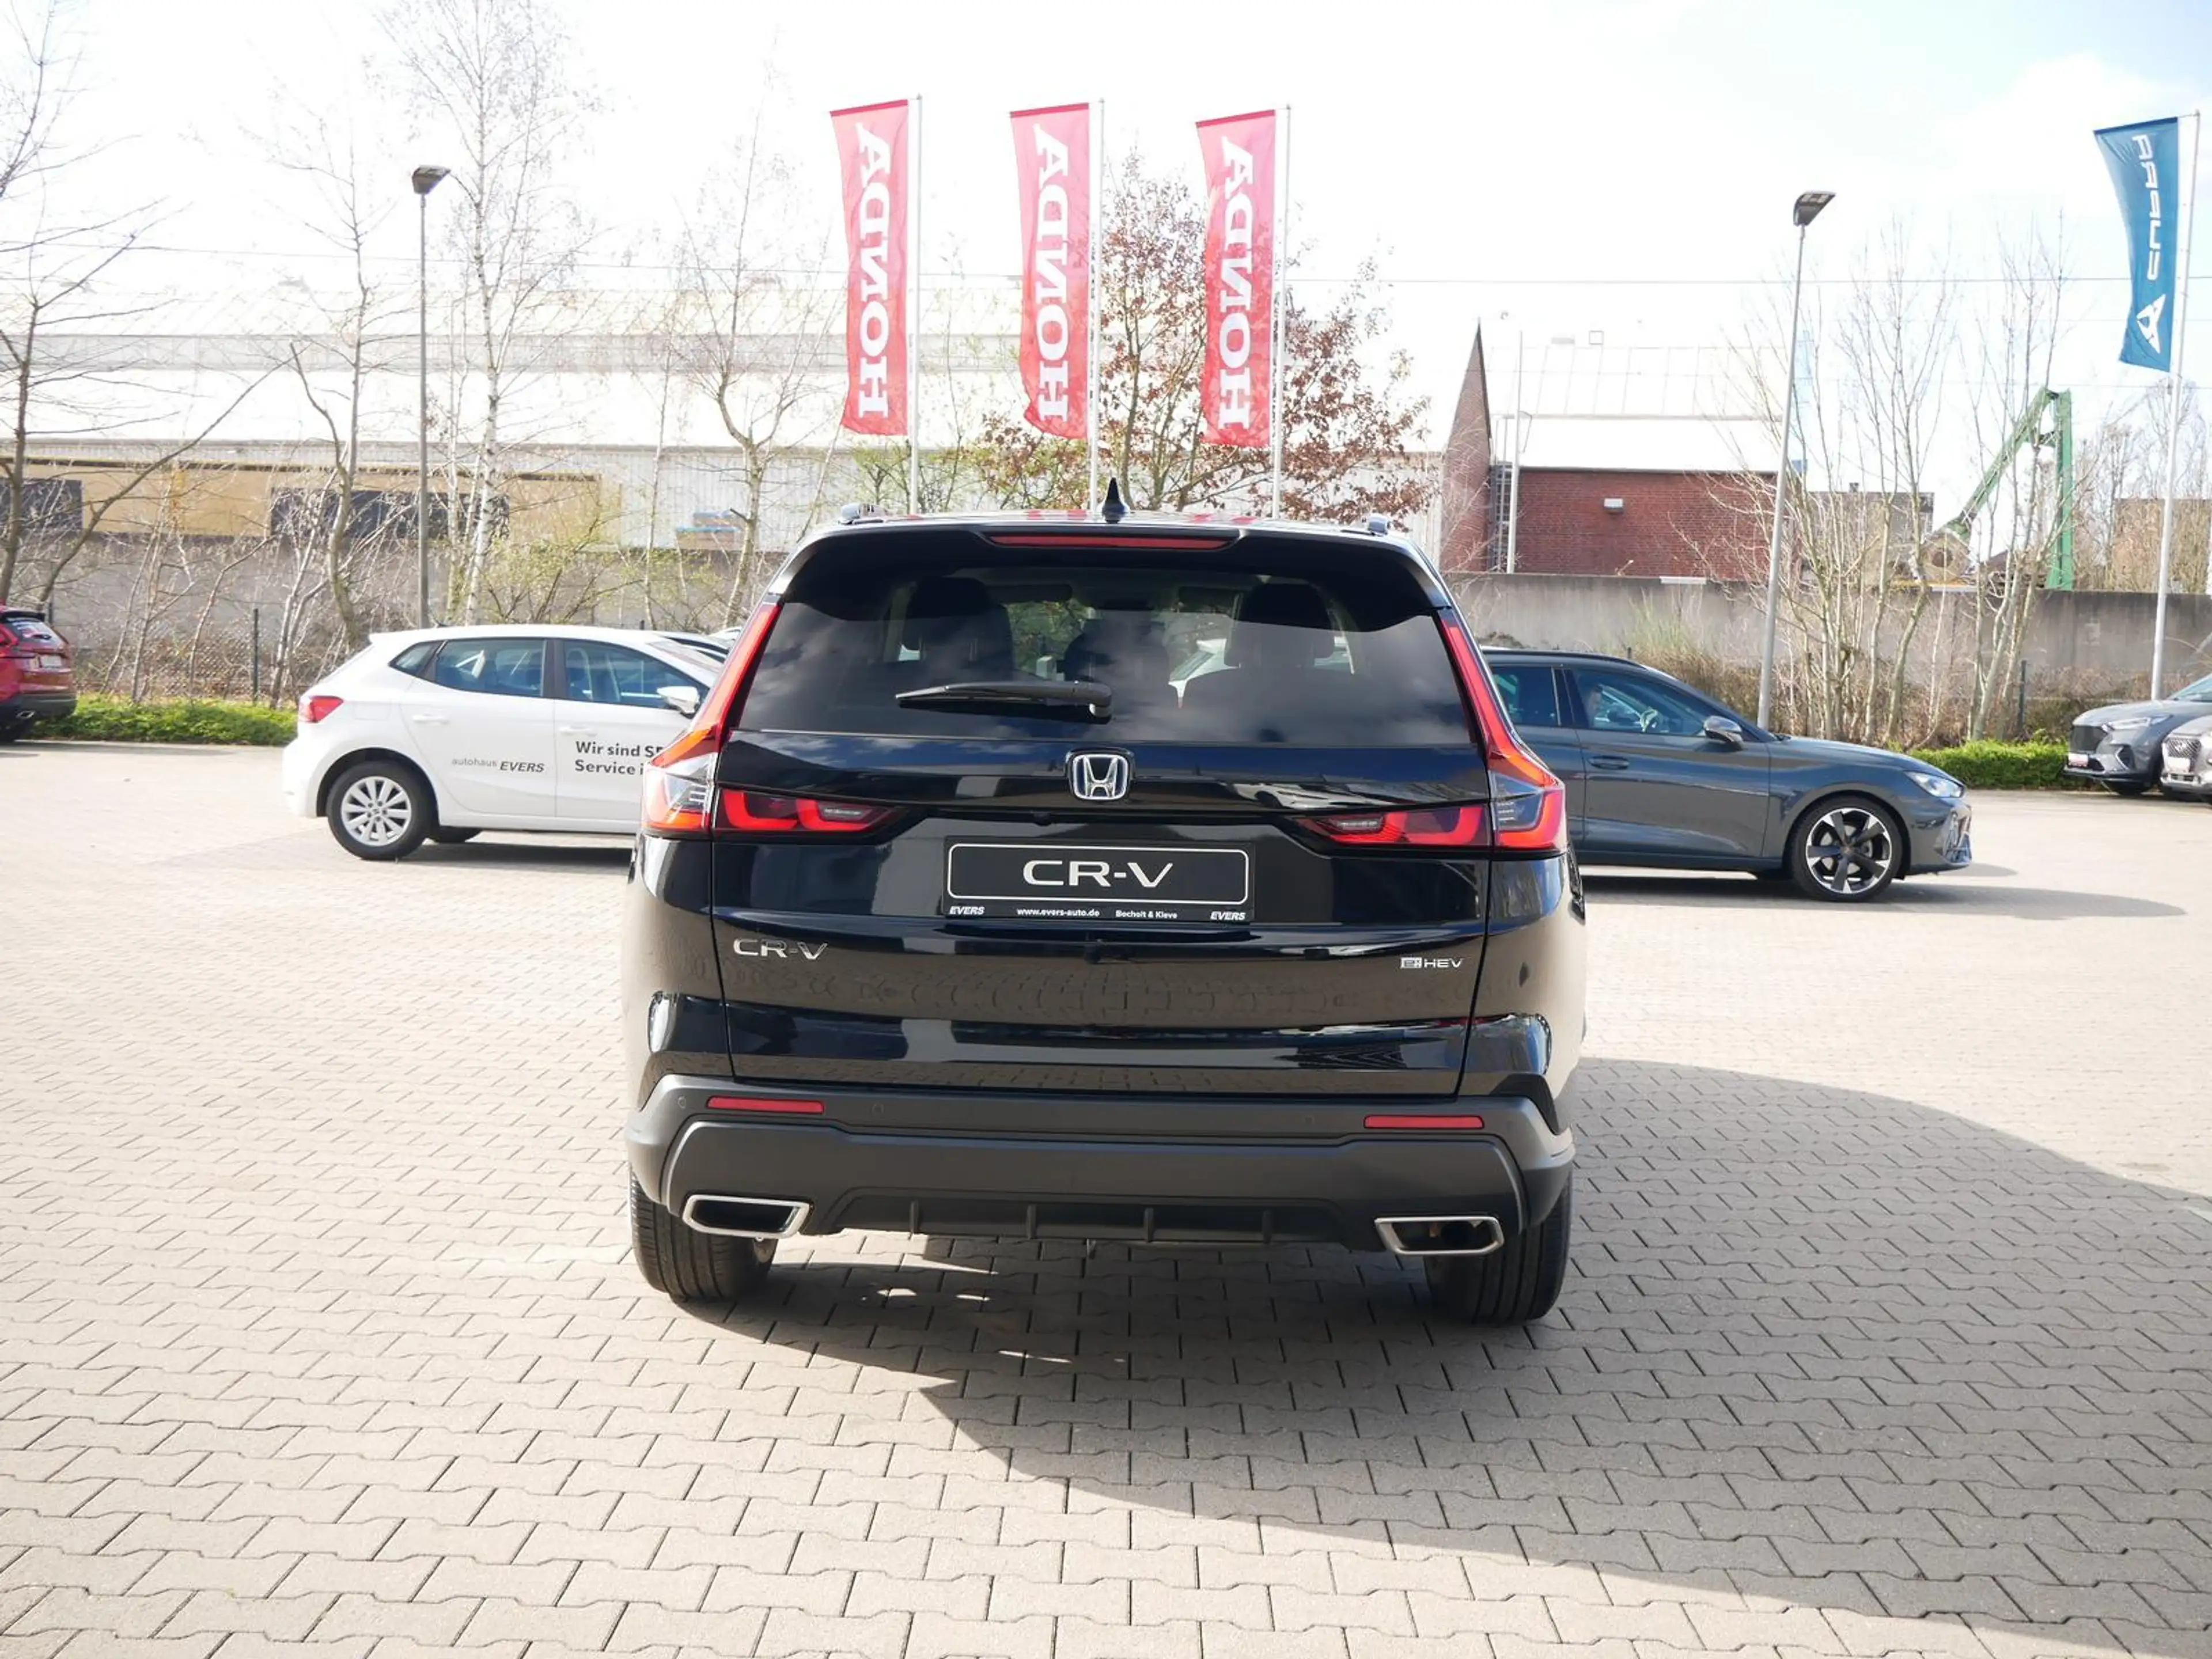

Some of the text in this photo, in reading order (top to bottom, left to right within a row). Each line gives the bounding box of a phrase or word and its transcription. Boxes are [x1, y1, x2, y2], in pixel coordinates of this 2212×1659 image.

[575, 741, 604, 754] Wir
[608, 742, 640, 757] sind
[452, 757, 544, 772] autohaus EVERS
[575, 759, 635, 775] Service
[1023, 860, 1173, 888] CR-V
[949, 906, 984, 915] EVERS
[1017, 908, 1100, 917] www.evers-auto.de
[1210, 911, 1246, 921] EVERS
[733, 939, 828, 960] CR-V
